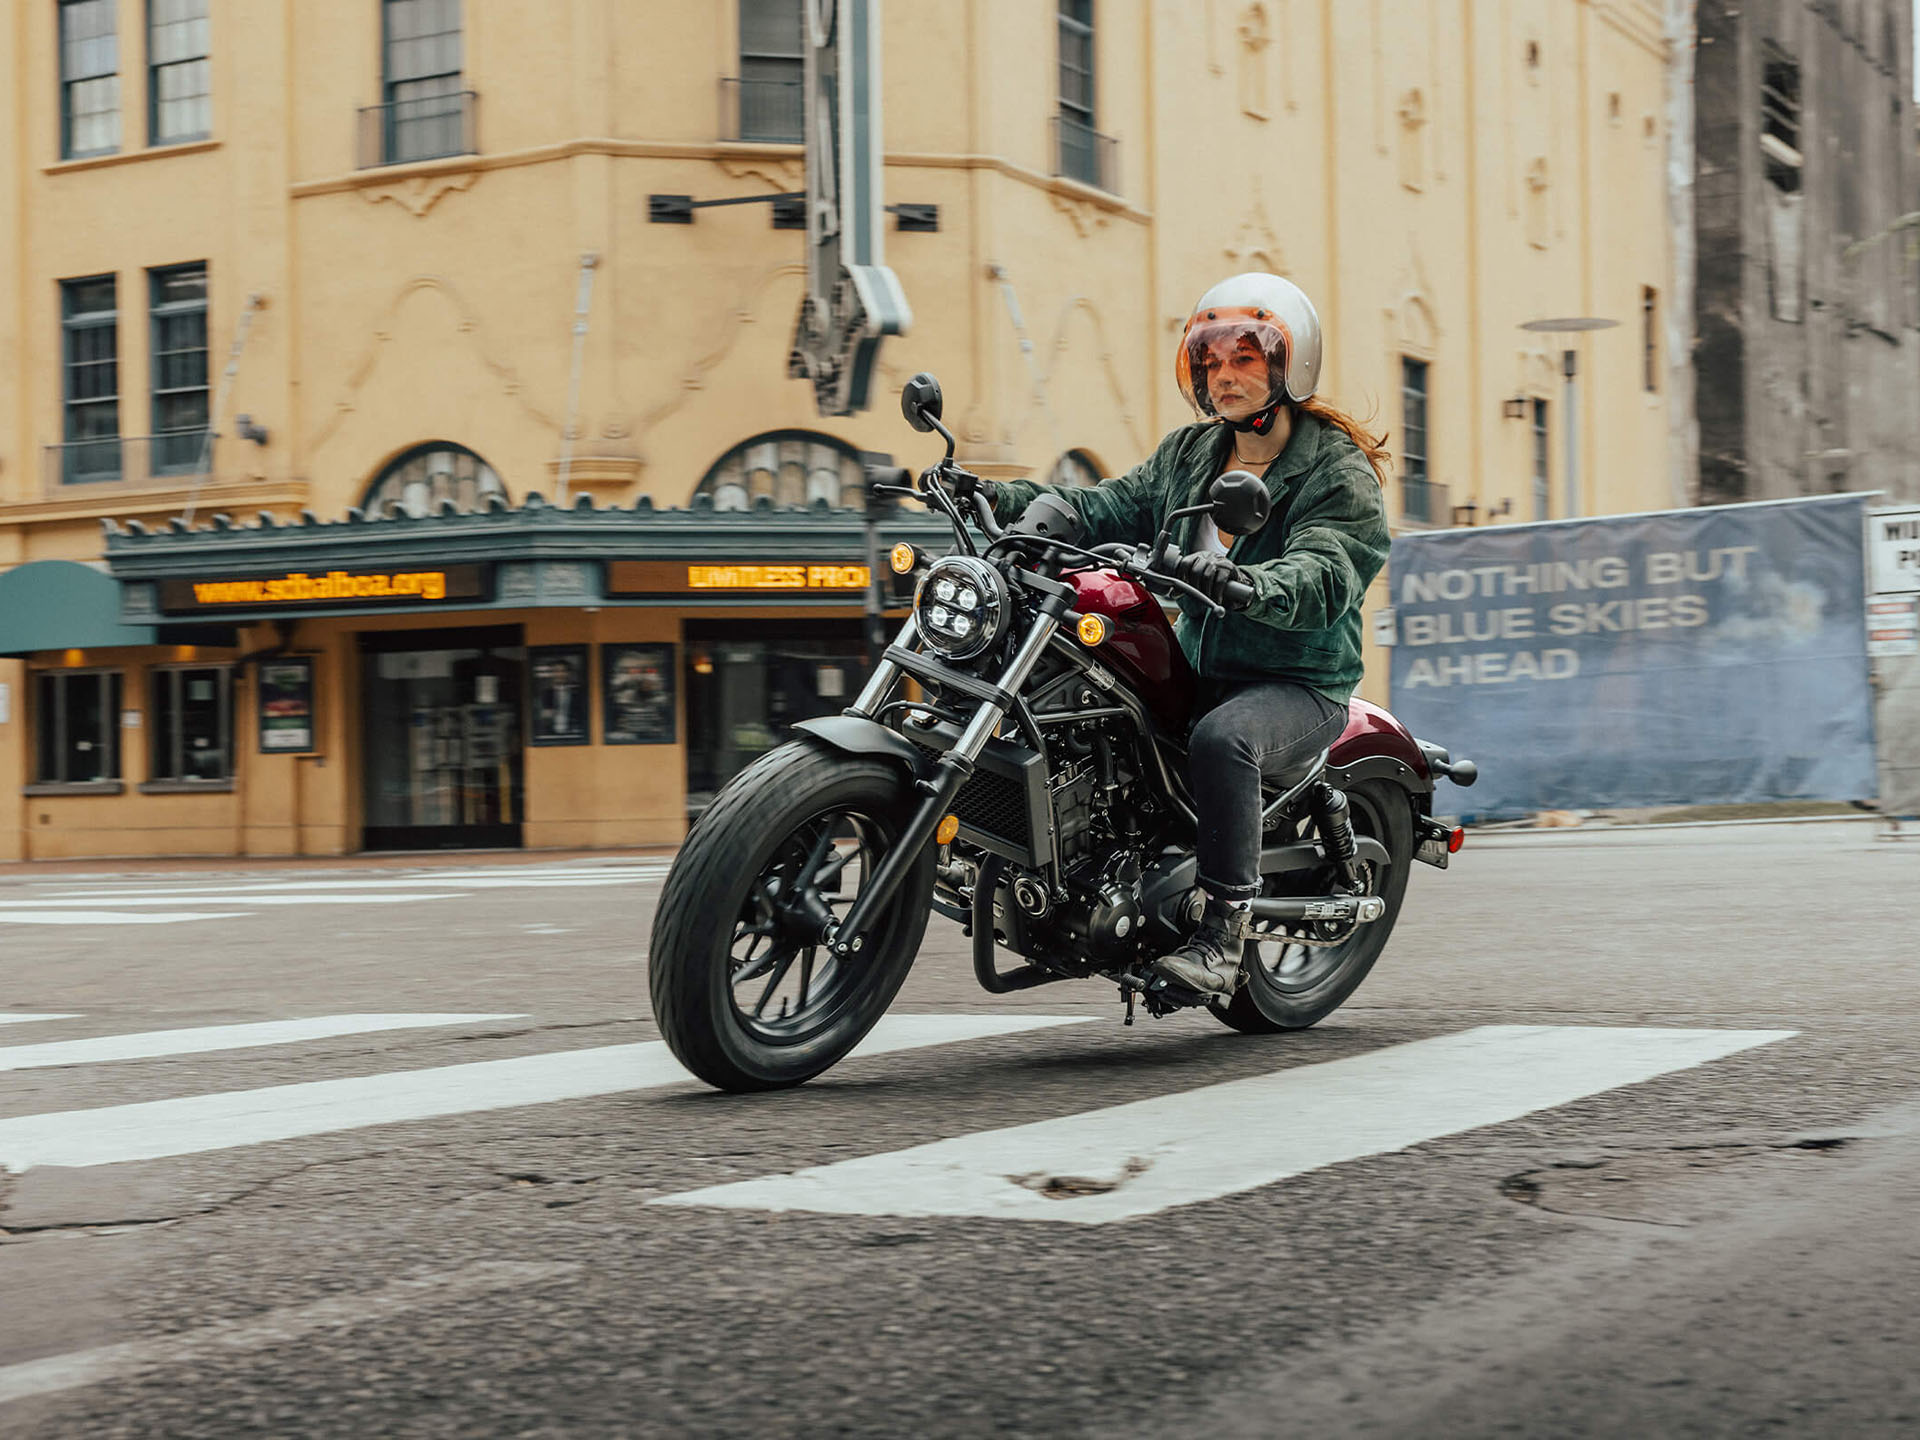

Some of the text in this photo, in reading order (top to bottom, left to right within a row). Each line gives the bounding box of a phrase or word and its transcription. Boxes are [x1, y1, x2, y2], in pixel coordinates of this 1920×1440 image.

[1402, 546, 1760, 603] NOTHING BUT
[1404, 595, 1709, 646] BLUE SKIES
[1403, 648, 1580, 688] AHEAD
